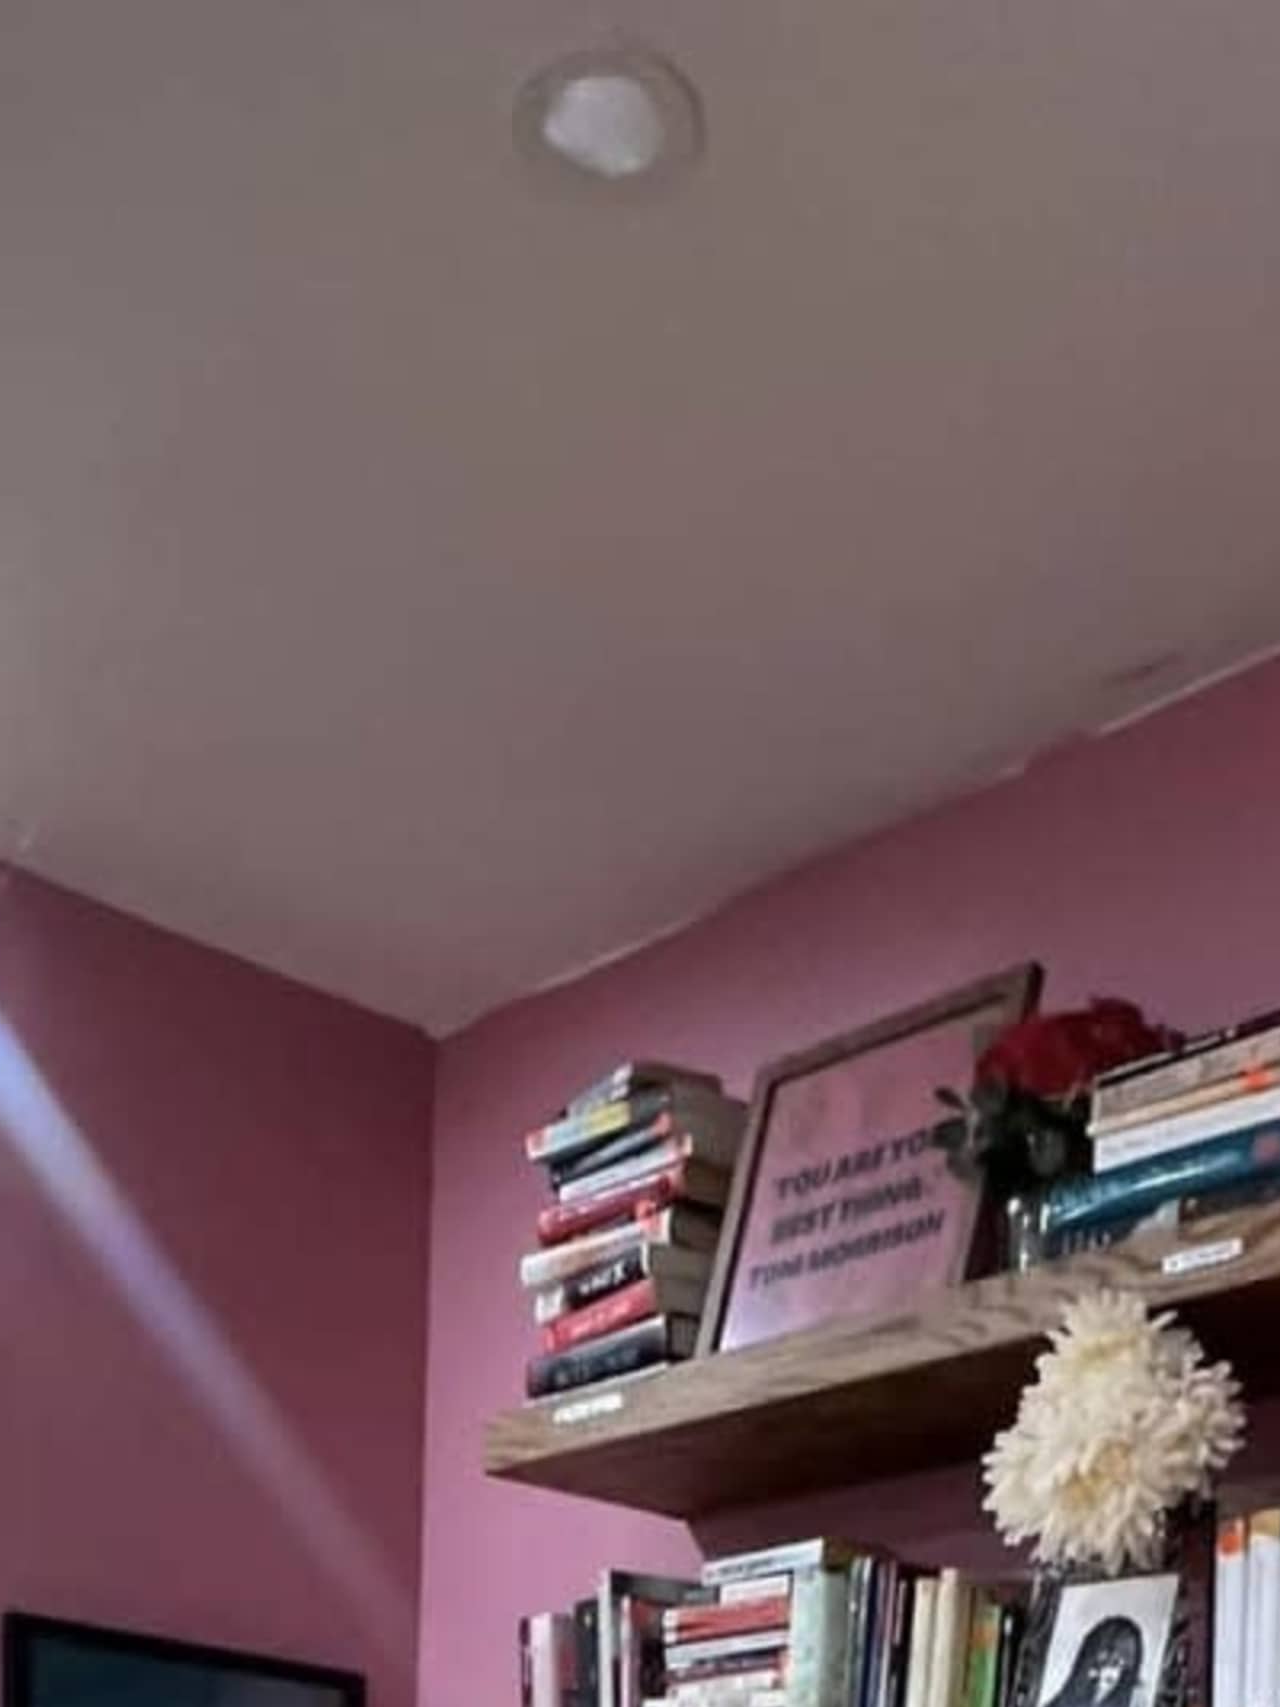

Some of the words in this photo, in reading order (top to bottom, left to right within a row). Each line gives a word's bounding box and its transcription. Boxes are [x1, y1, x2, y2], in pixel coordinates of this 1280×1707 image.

[775, 1158, 830, 1199] YOU
[831, 1143, 885, 1183] ARE
[770, 1202, 836, 1245] BEST
[807, 1207, 946, 1272] MORRISON
